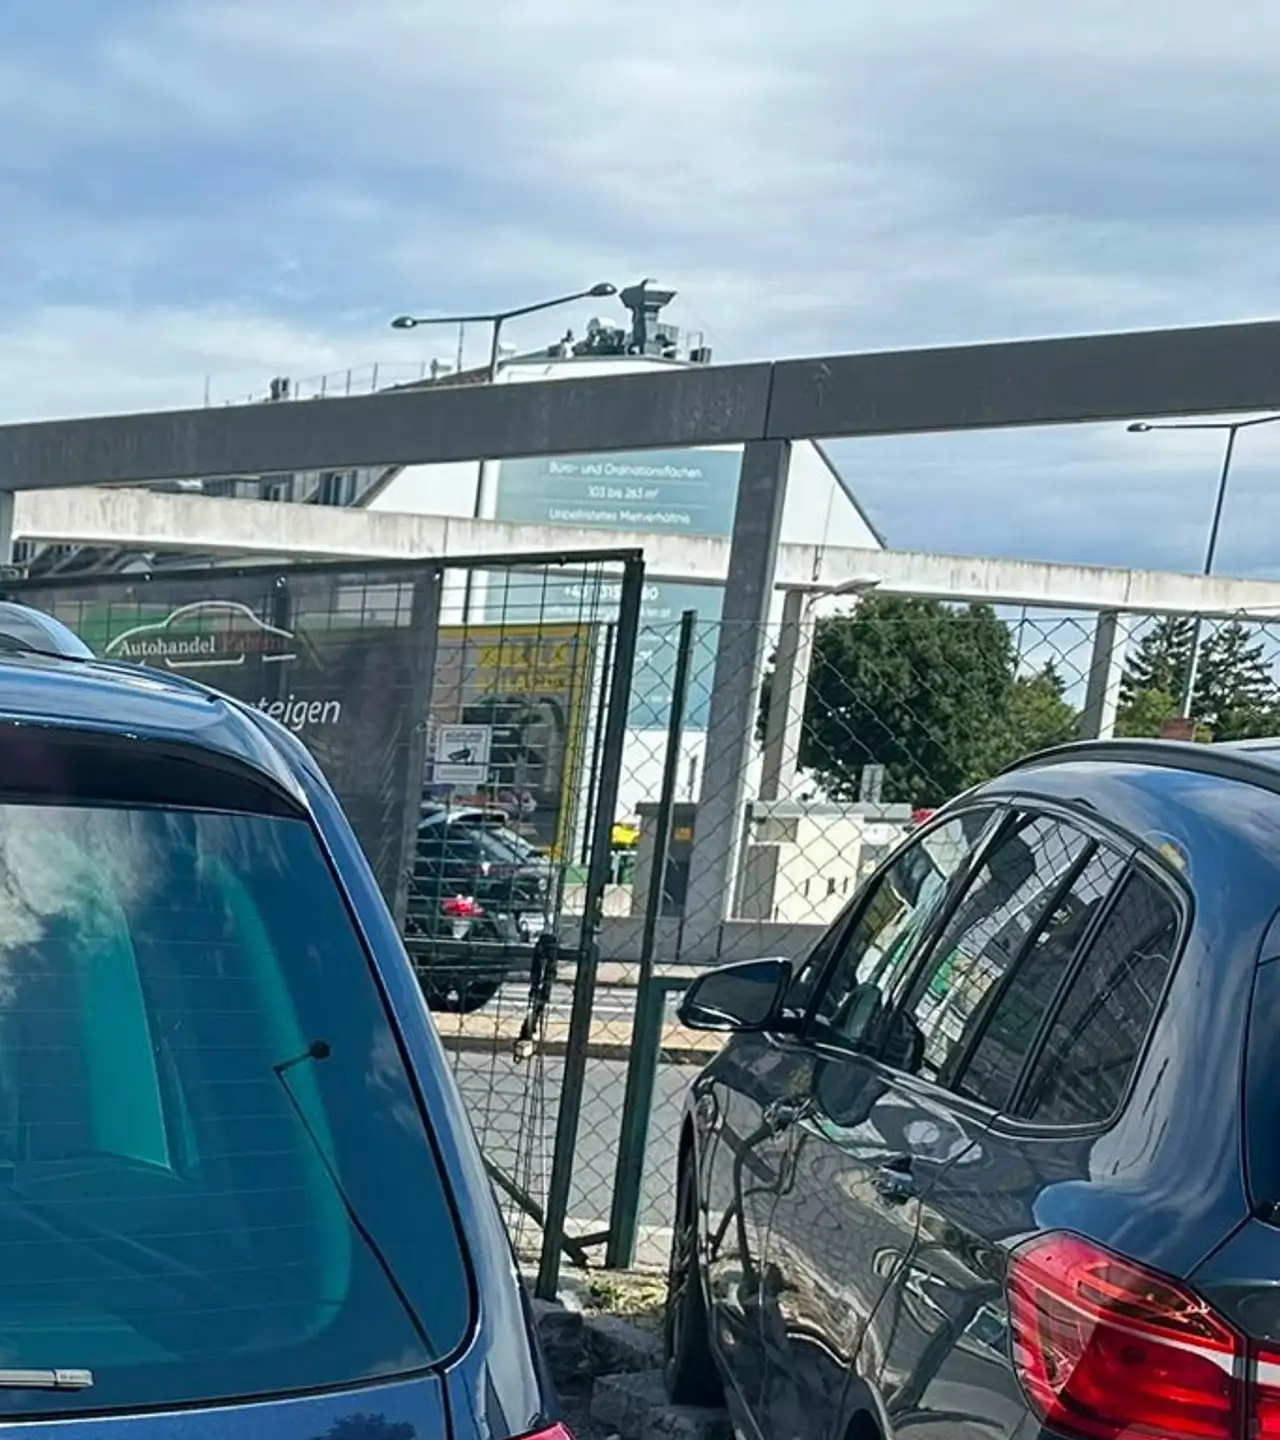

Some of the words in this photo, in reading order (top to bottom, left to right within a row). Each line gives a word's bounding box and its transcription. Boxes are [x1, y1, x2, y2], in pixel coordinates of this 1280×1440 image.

[581, 462, 603, 476] und
[118, 635, 216, 657] Autohandel
[250, 693, 341, 731] teigen
